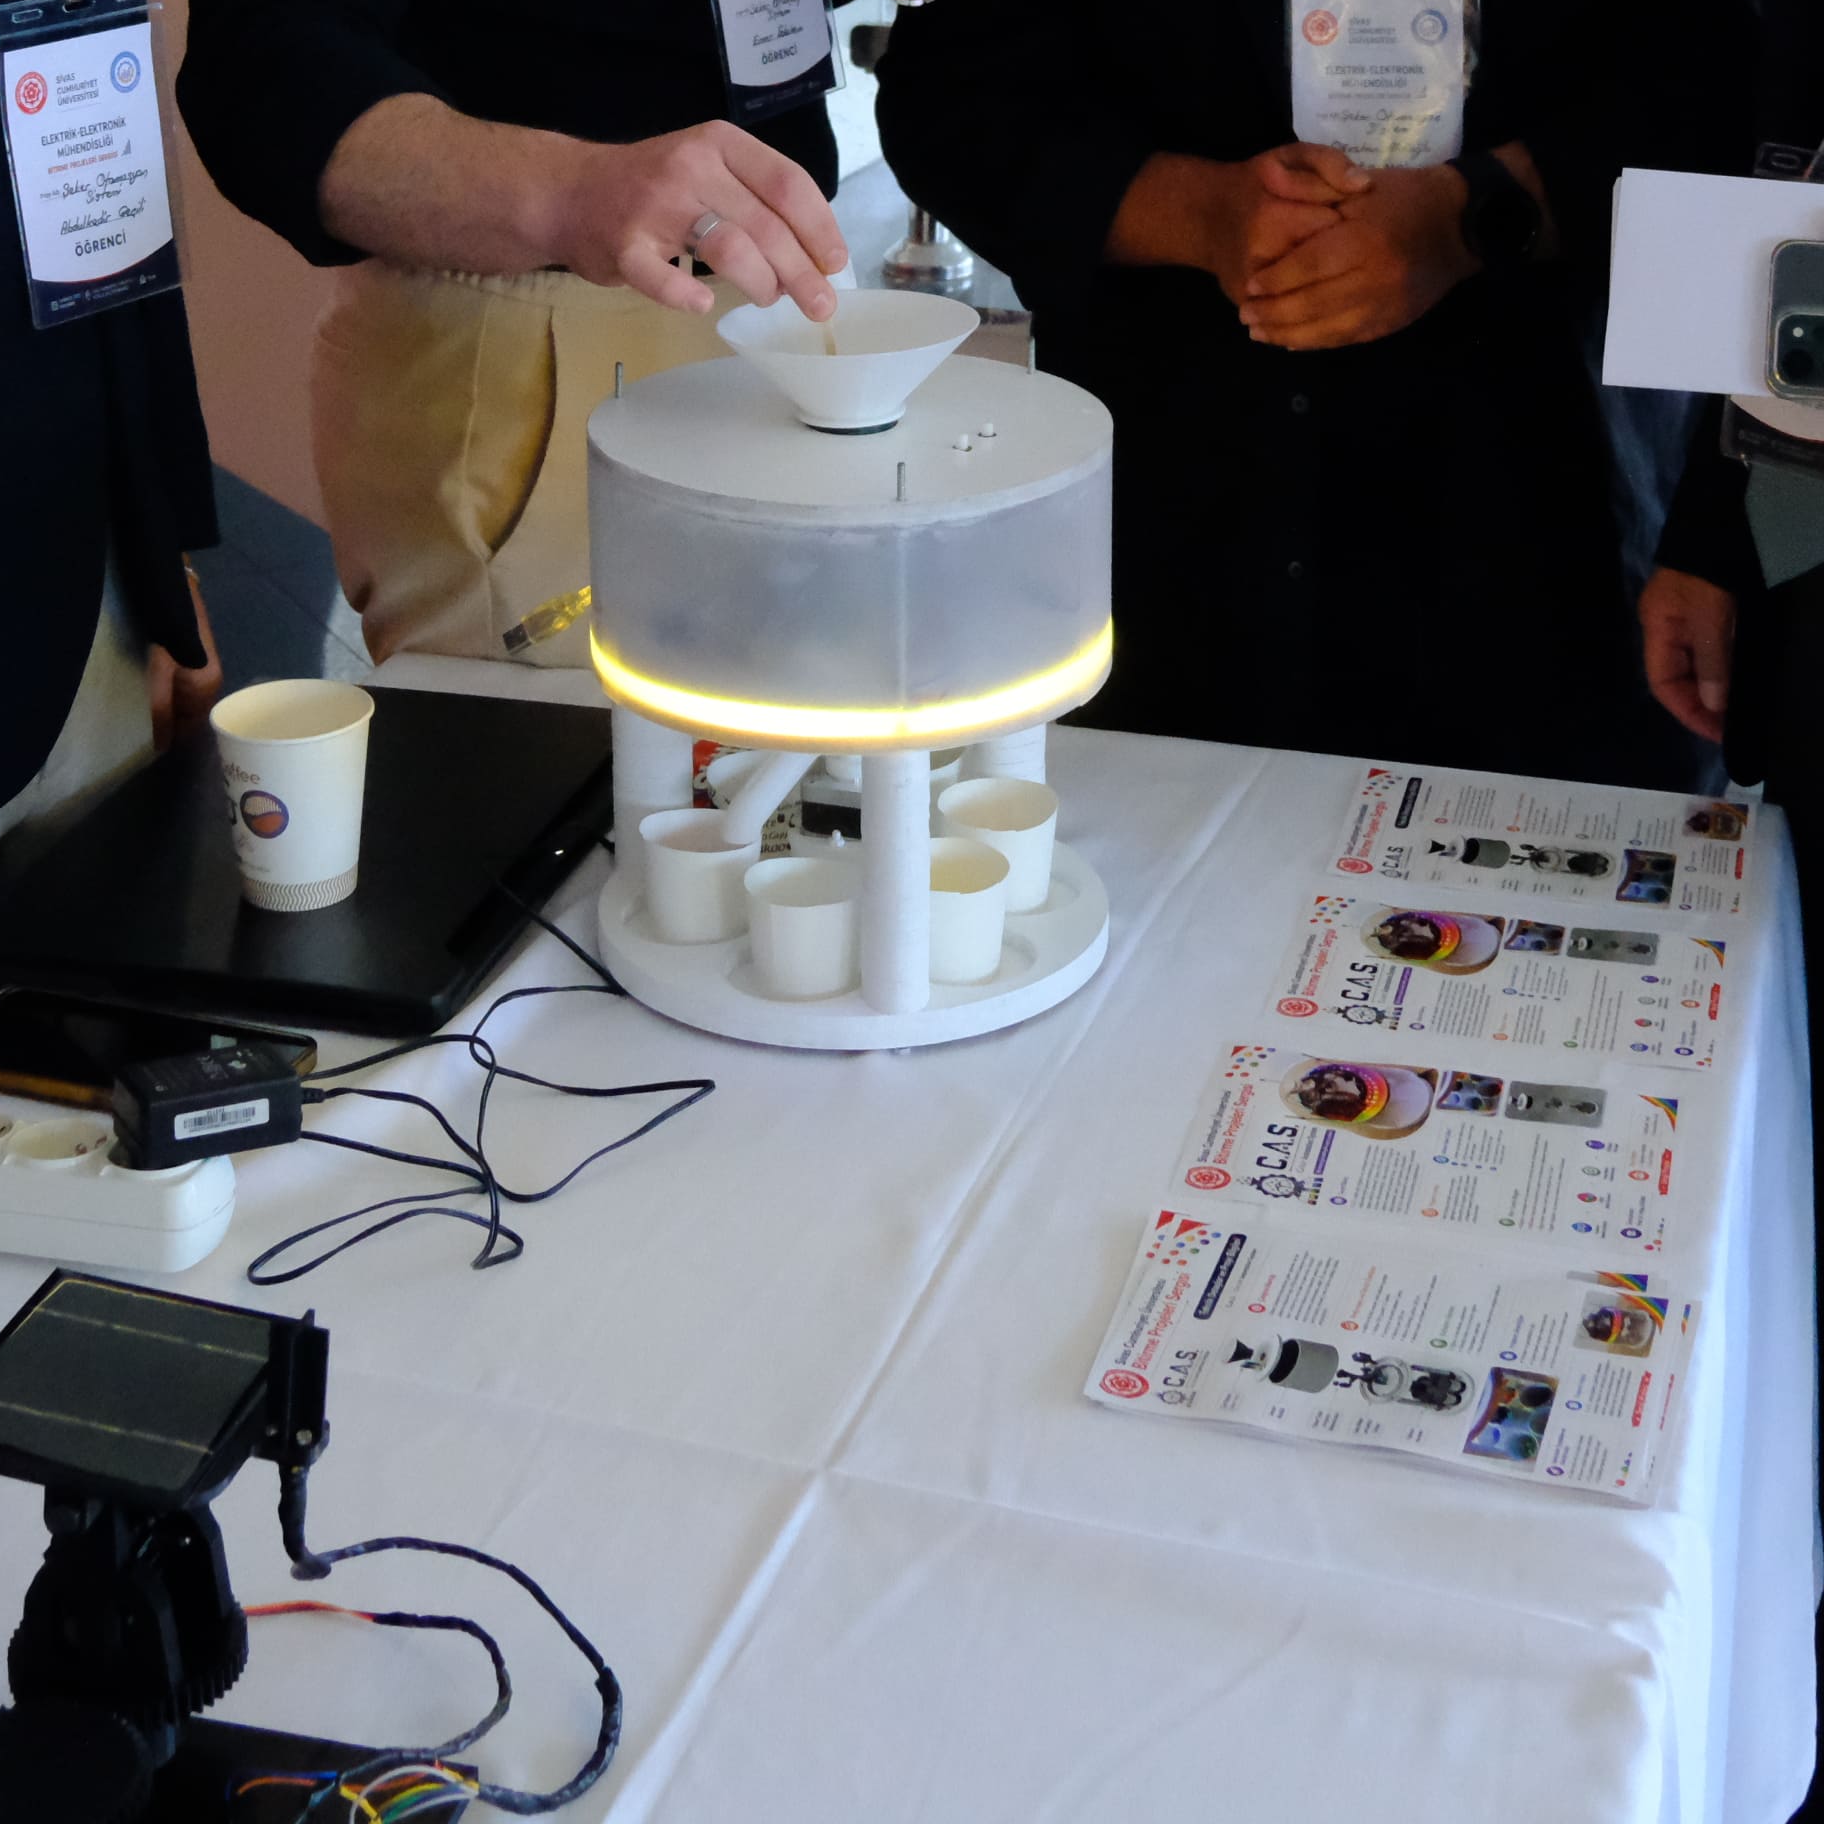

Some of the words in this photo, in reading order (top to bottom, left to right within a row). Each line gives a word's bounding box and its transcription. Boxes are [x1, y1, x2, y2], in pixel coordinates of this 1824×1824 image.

[56, 72, 76, 84] SİVAS
[57, 78, 98, 95] CUMHURİYET
[57, 88, 99, 106] ÜNİVERSİTESİ
[41, 116, 126, 146] ELEKTRİK-ELEKTRONİK
[57, 133, 114, 158] MÜHENDİSLİĞİ
[75, 228, 127, 256] ÖĞRENCİ
[1256, 1123, 1299, 1170] C.A.S.
[1131, 1338, 1160, 1371] Bitirme
[1147, 1303, 1176, 1338] Projeleri
